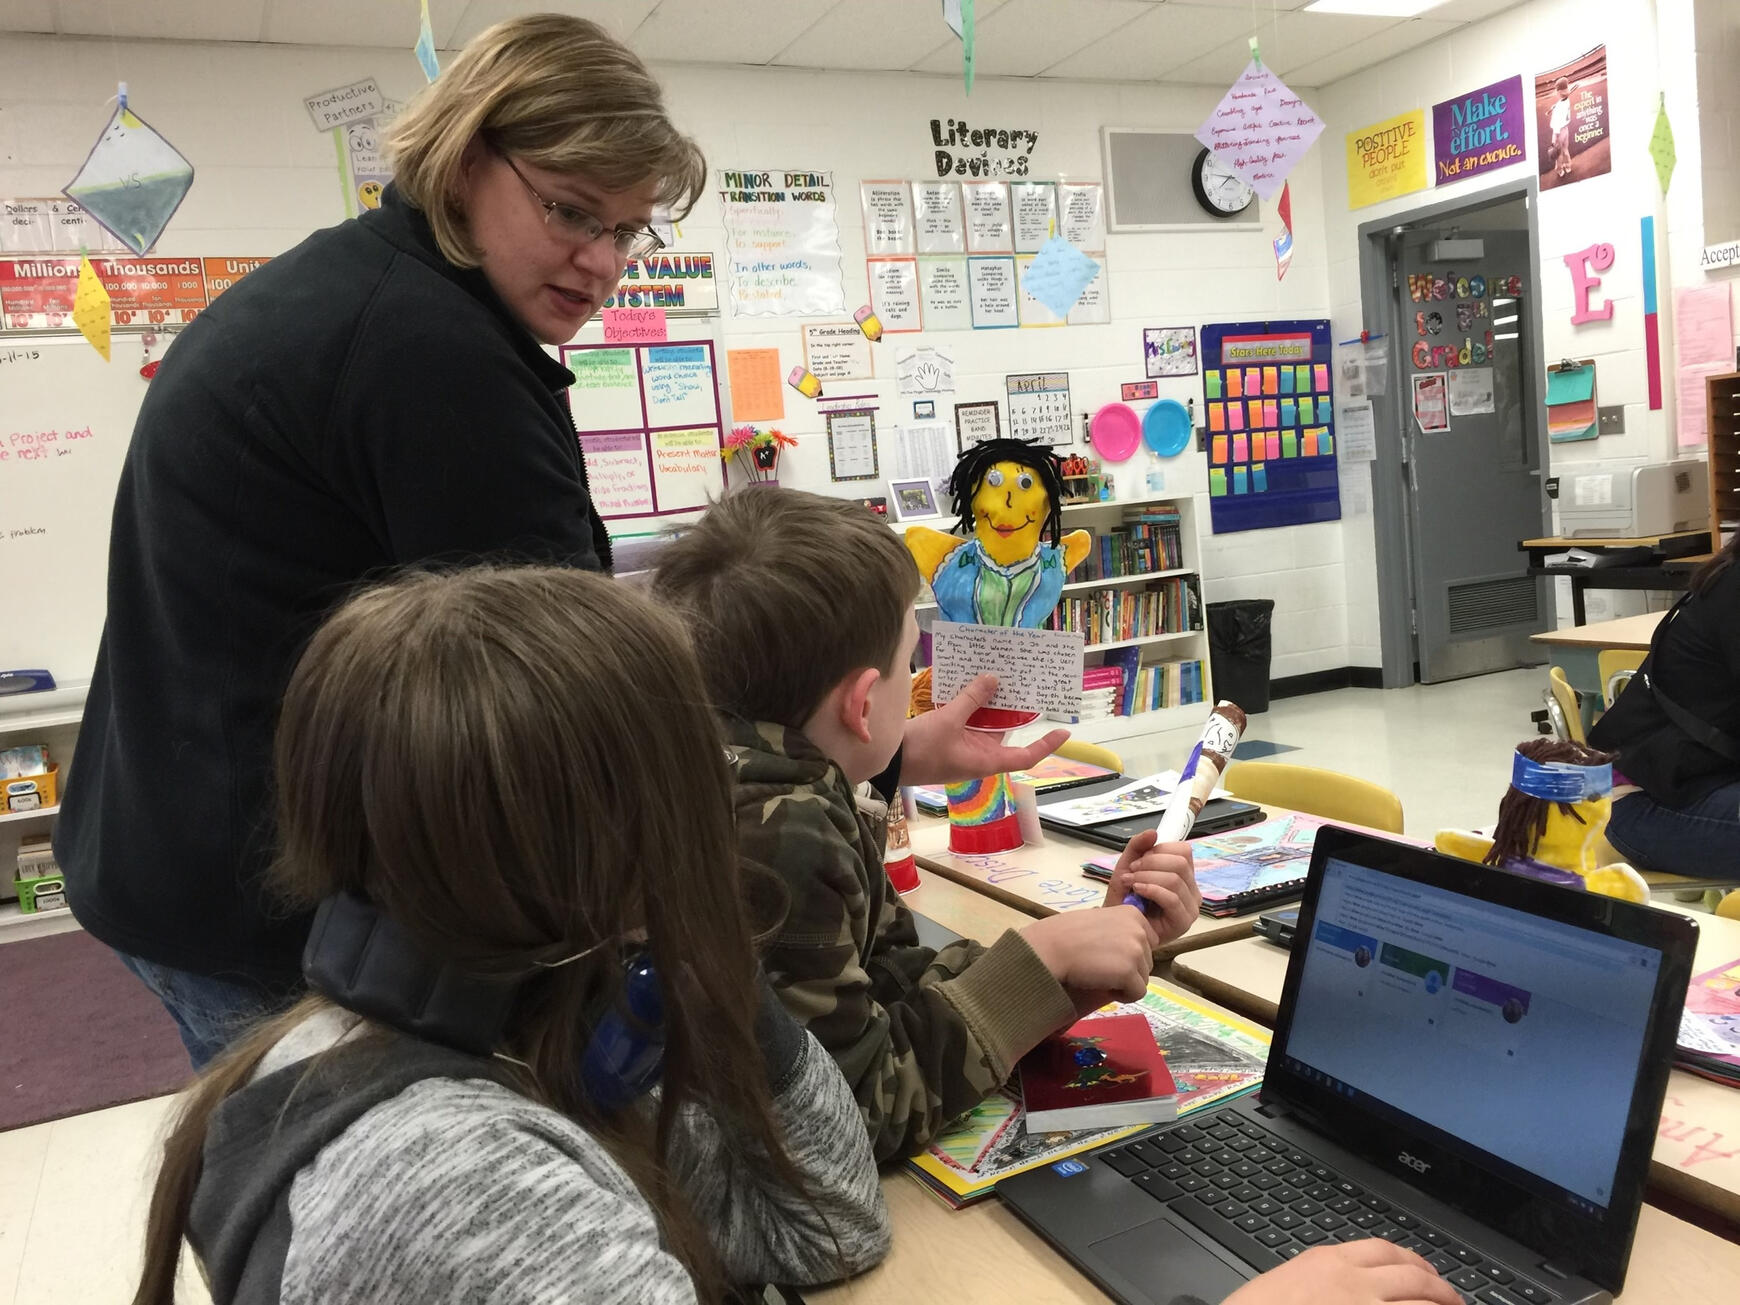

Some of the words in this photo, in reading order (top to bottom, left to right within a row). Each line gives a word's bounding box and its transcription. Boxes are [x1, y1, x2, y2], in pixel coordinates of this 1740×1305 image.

[308, 85, 376, 111] Productive
[323, 101, 376, 123] Partners
[1450, 92, 1508, 130] Make
[930, 119, 1039, 154] Literary
[1355, 121, 1417, 155] POSITIVE
[1450, 119, 1511, 157] effort.
[935, 151, 1029, 177] Devices
[1362, 140, 1411, 168] PEOPLE
[1439, 158, 1462, 180] Not
[1463, 154, 1479, 170] an
[725, 172, 773, 189] MINOR
[784, 173, 830, 189] DETAIL
[719, 191, 786, 203] TRANSITION
[792, 191, 826, 203] WORDS
[6, 204, 38, 215] Dollars
[53, 205, 59, 213] &
[104, 262, 200, 275] Thousands
[226, 260, 265, 274] Unit
[643, 255, 713, 280] VALUE
[735, 262, 748, 273] In
[752, 262, 776, 273] other
[779, 260, 812, 272] words,
[1700, 244, 1740, 270] Accept
[737, 277, 749, 287] To
[1564, 242, 1616, 327] E
[611, 309, 656, 323] Today's
[1416, 312, 1443, 337] to
[819, 328, 836, 336] Grade
[838, 328, 861, 336] Heading
[1230, 346, 1253, 358] Stars
[1256, 346, 1276, 356] Here
[1279, 343, 1303, 355] Today
[964, 416, 992, 425] PRACTICE
[9, 429, 58, 447] Project
[65, 425, 94, 440] and
[656, 449, 691, 459] Present
[658, 463, 708, 477] Vocabulary
[959, 625, 998, 636] Character
[998, 653, 1028, 662] because
[1397, 1150, 1432, 1175] acer
